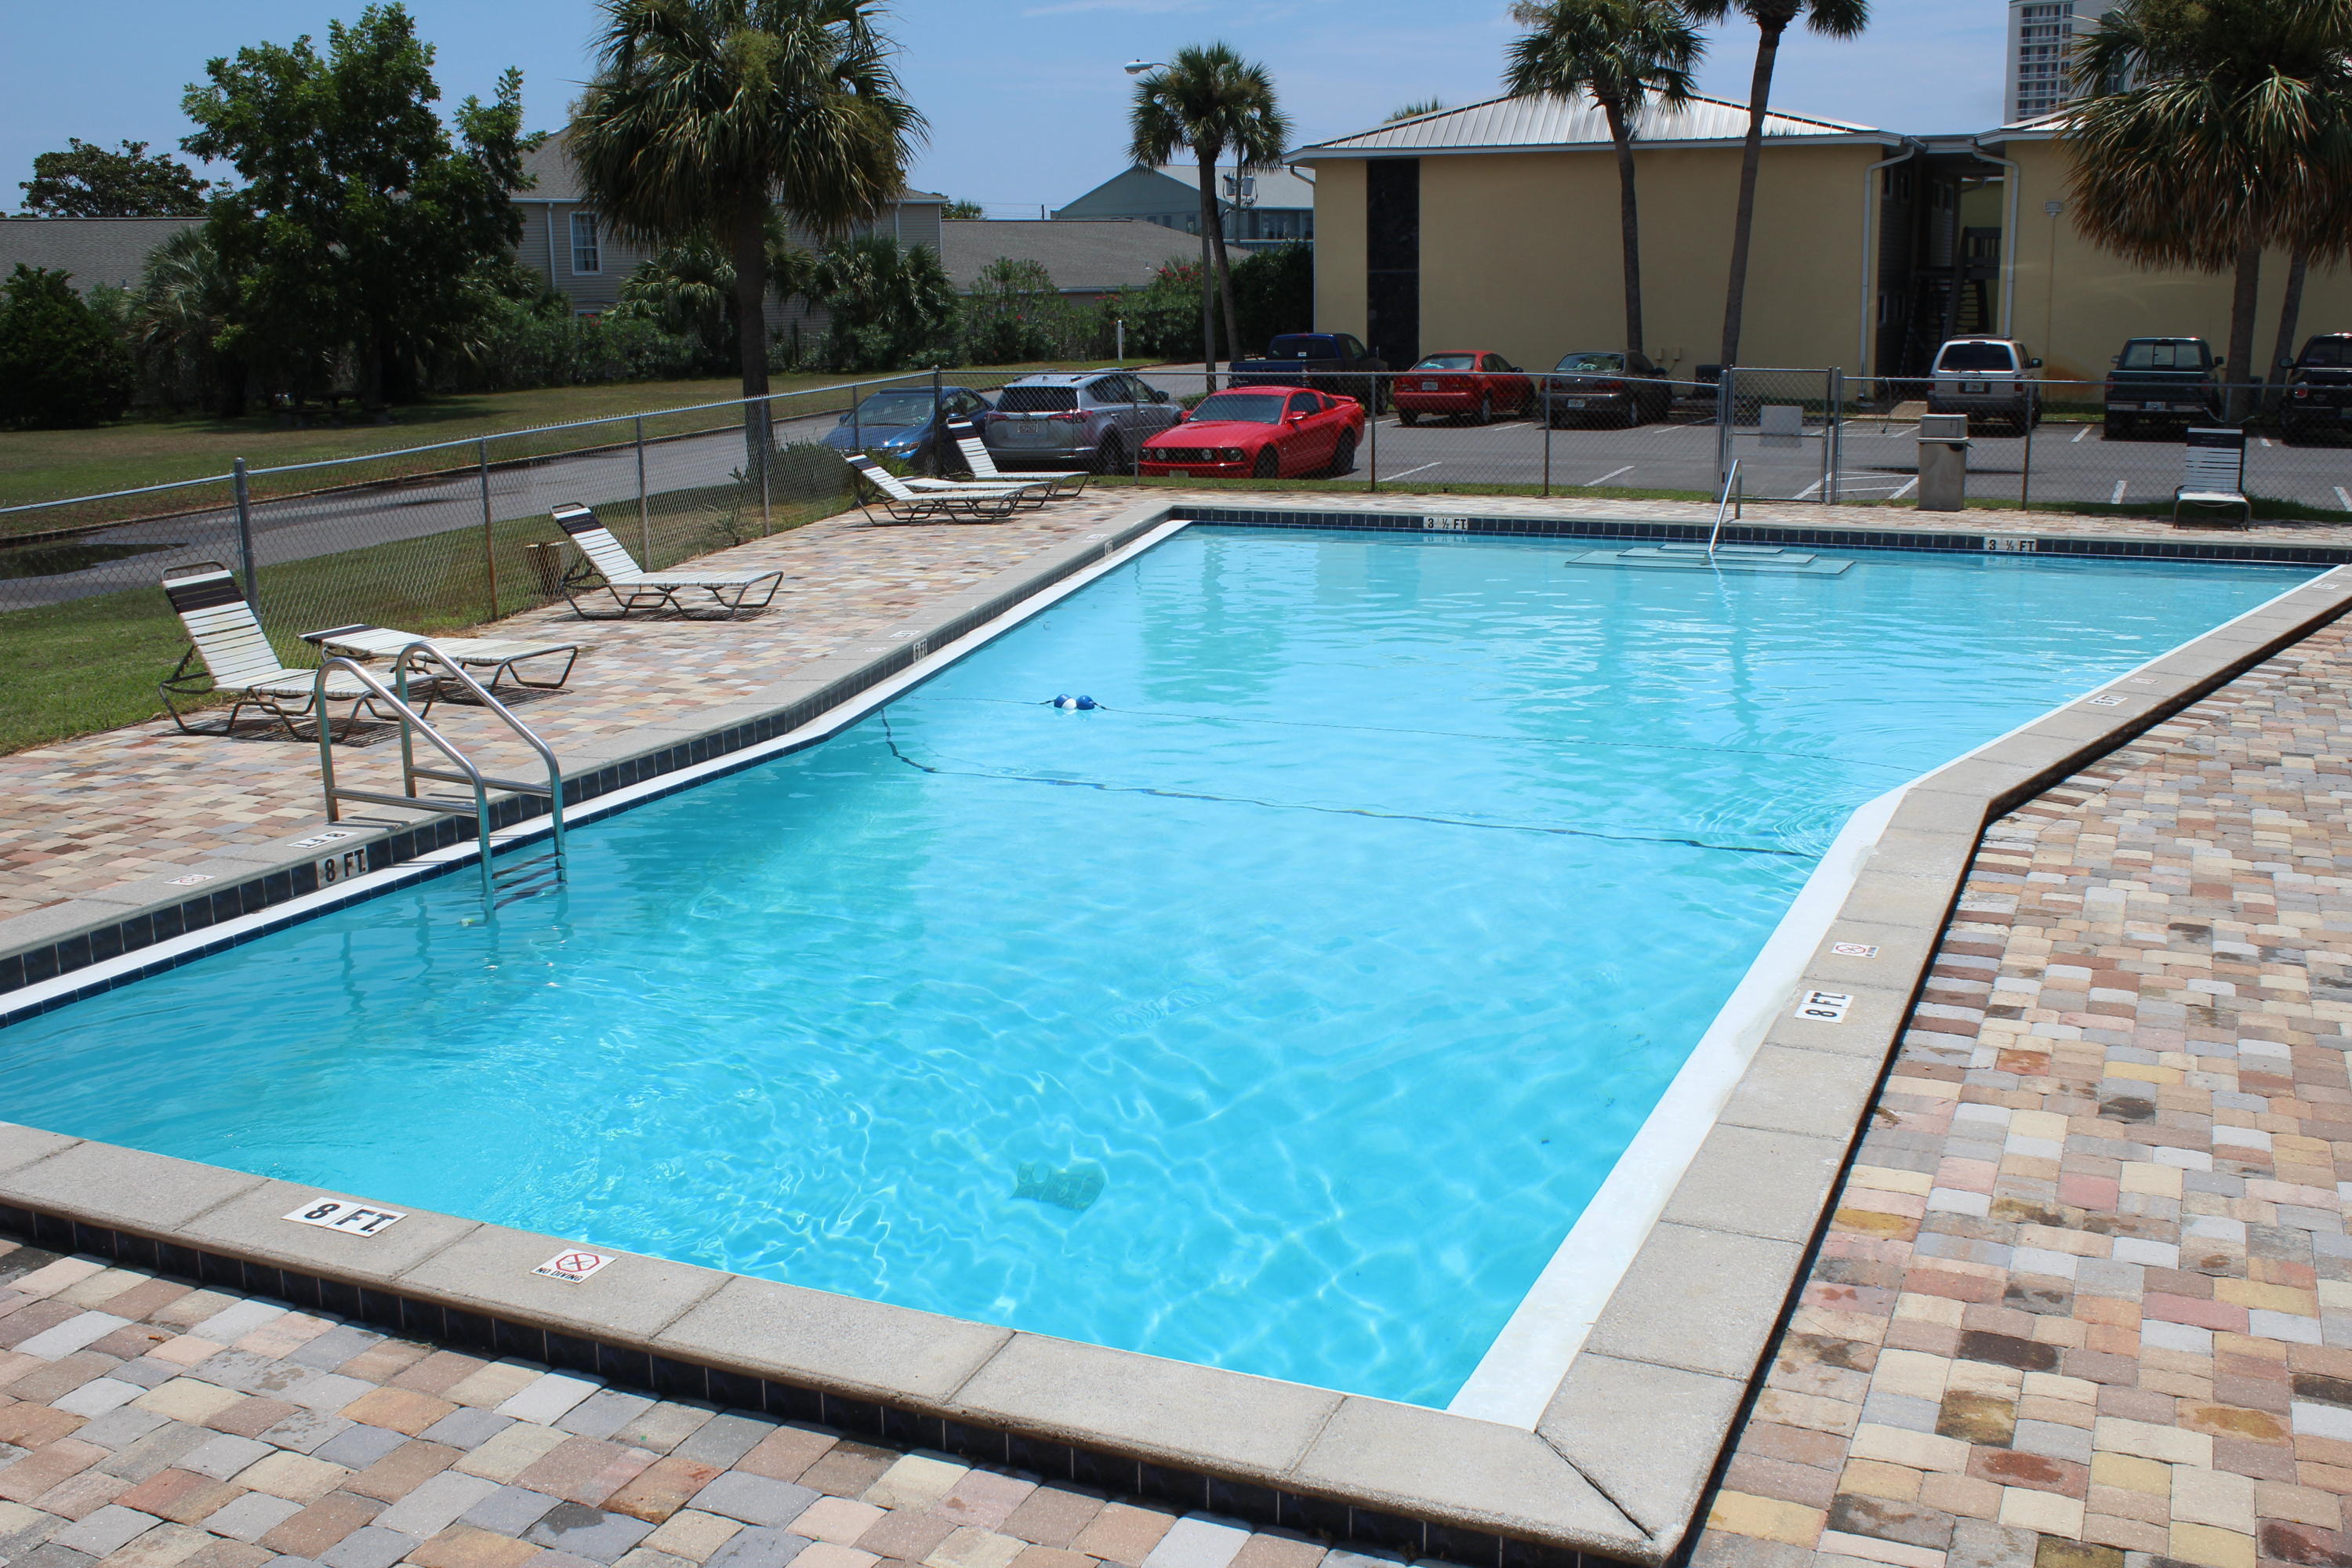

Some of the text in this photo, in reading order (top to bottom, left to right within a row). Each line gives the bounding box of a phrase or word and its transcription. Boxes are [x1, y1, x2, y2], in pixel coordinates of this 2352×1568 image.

[1428, 518, 1434, 528] 3
[1988, 539, 1996, 550] 3
[325, 858, 336, 882] 8
[1804, 1009, 1838, 1018] 8
[304, 1203, 340, 1219] 8
[550, 1269, 583, 1282] DIVING
